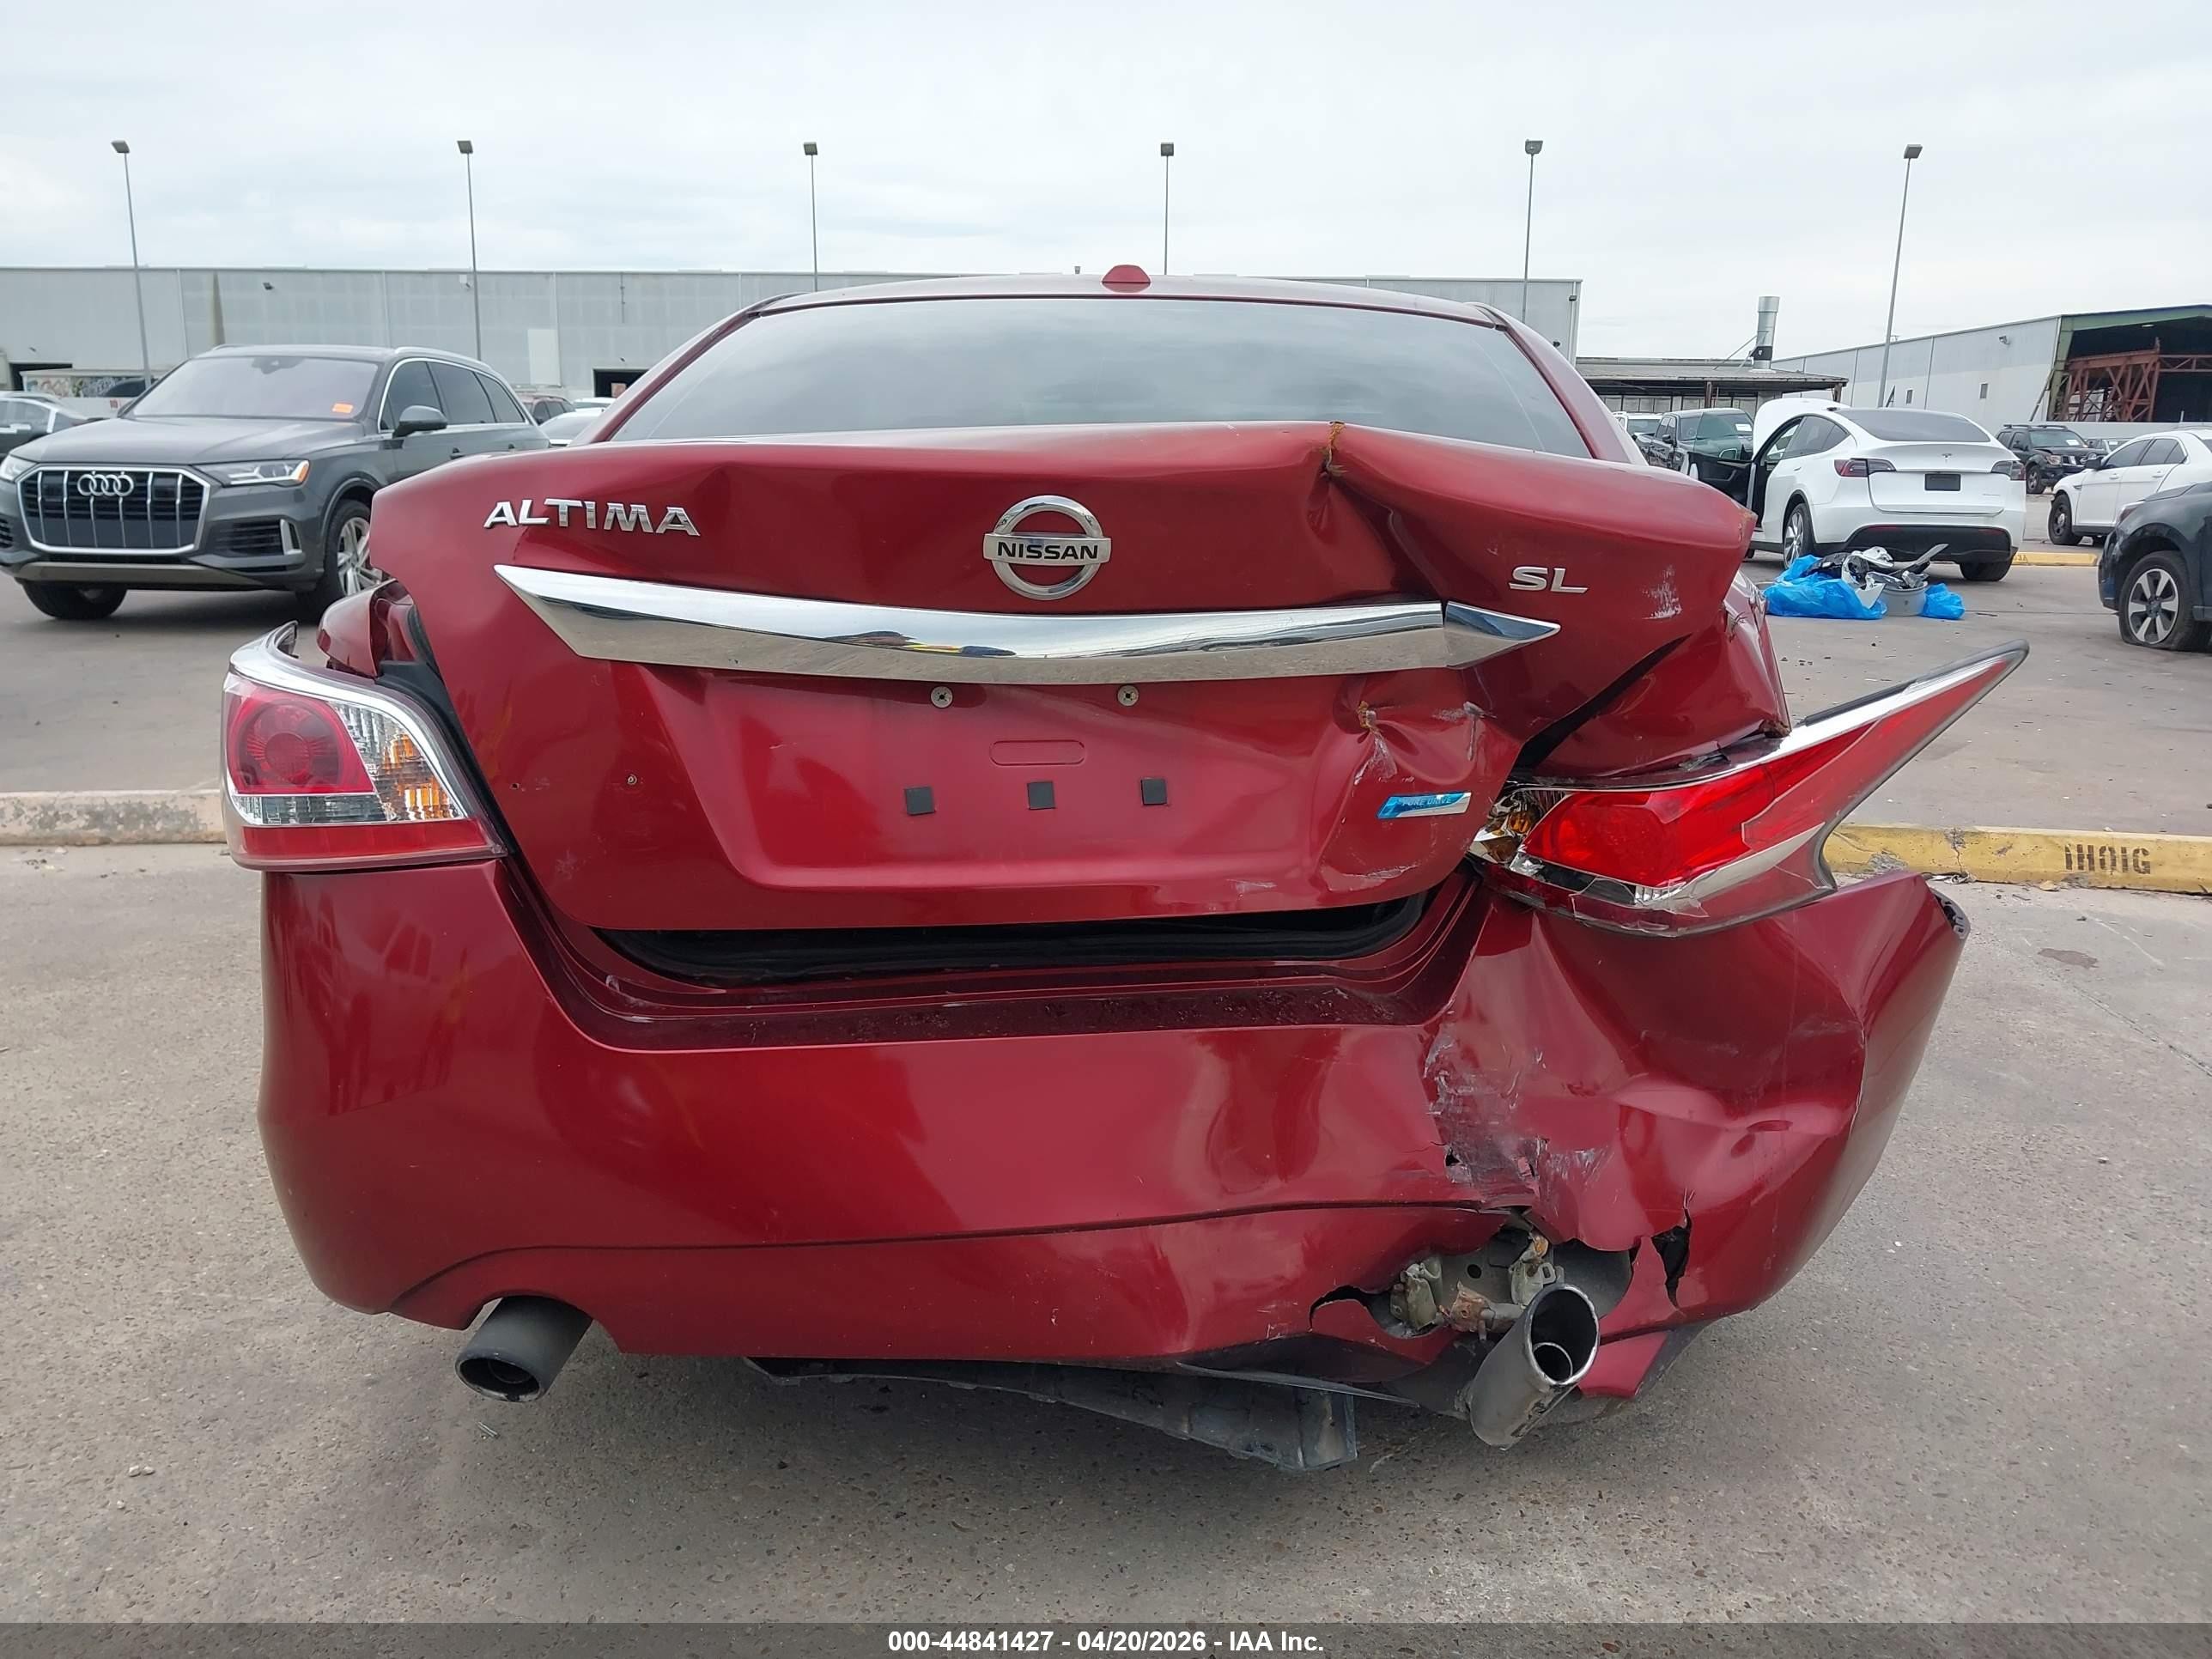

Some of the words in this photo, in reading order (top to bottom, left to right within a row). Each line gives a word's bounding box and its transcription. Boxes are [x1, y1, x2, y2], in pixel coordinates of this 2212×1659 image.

[483, 498, 701, 537] ALTIMA
[997, 541, 1098, 560] NISSAN
[1508, 566, 1589, 593] SL
